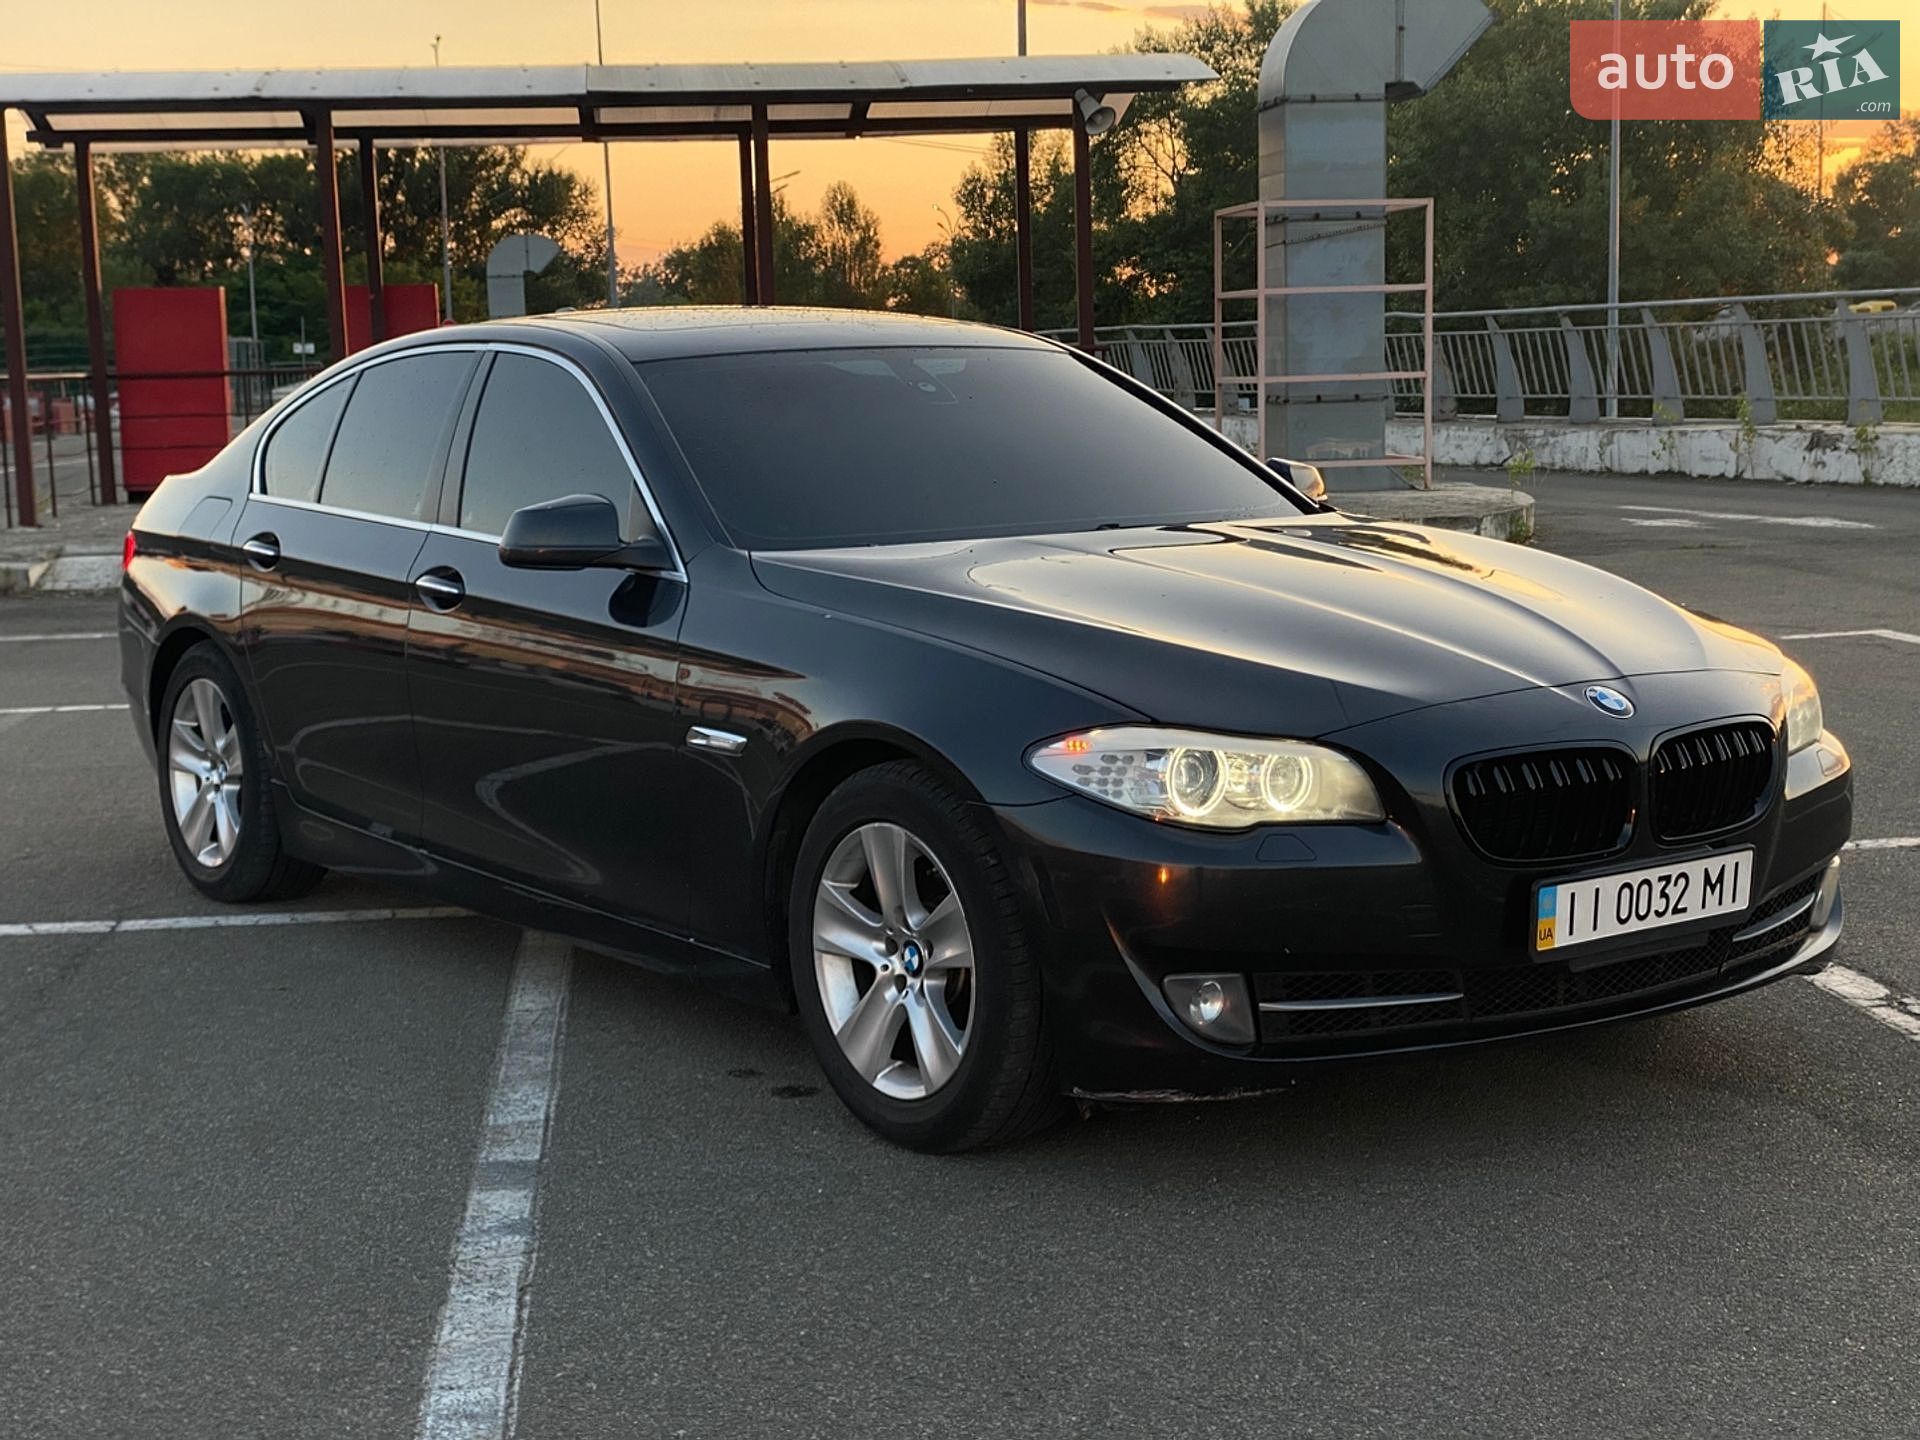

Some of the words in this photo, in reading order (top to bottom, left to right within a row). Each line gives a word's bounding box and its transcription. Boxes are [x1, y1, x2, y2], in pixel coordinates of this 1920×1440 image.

[1615, 871, 1690, 925] 0032
[1701, 861, 1740, 910] MI
[1538, 927, 1554, 942] UA
